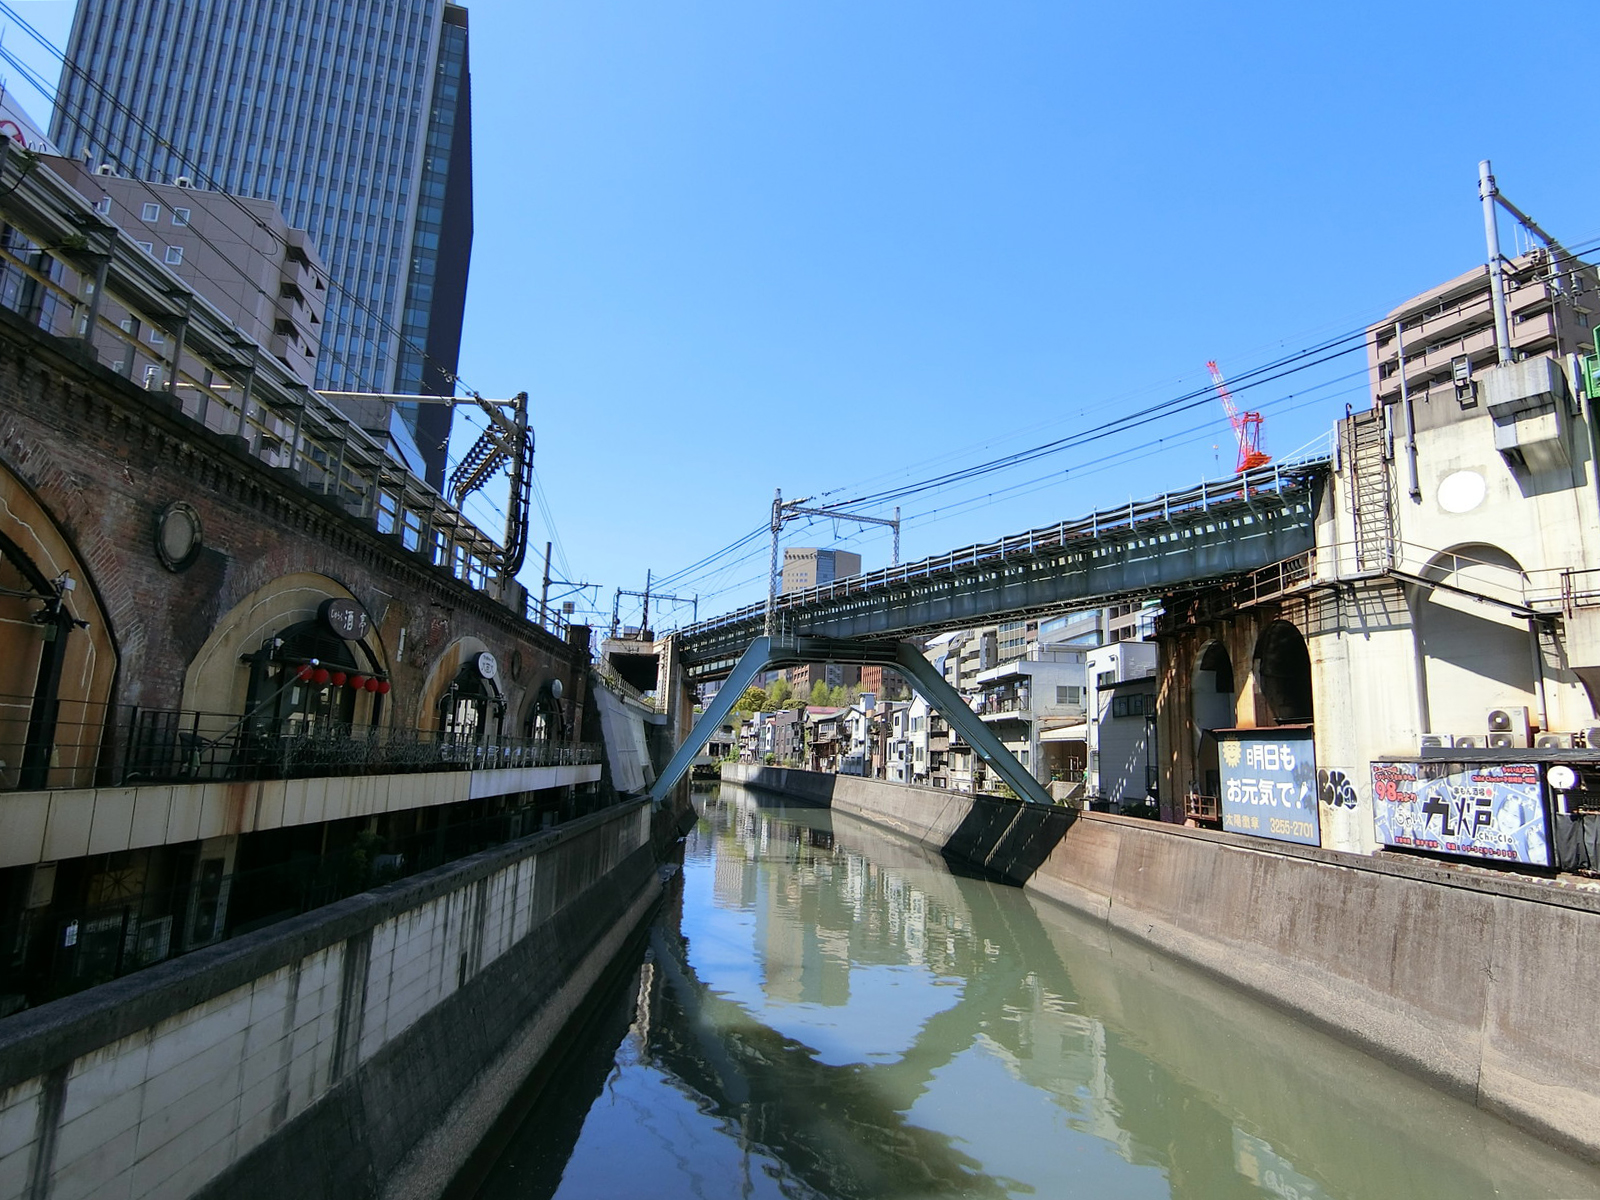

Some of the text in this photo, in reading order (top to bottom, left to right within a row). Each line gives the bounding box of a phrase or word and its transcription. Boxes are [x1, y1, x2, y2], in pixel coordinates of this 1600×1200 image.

[343, 609, 367, 637] 酒亭
[1246, 744, 1296, 771] 明日も
[1269, 817, 1314, 839] 3255-2701
[1421, 796, 1492, 839] 九炉
[1478, 832, 1514, 844] Chi-Clo
